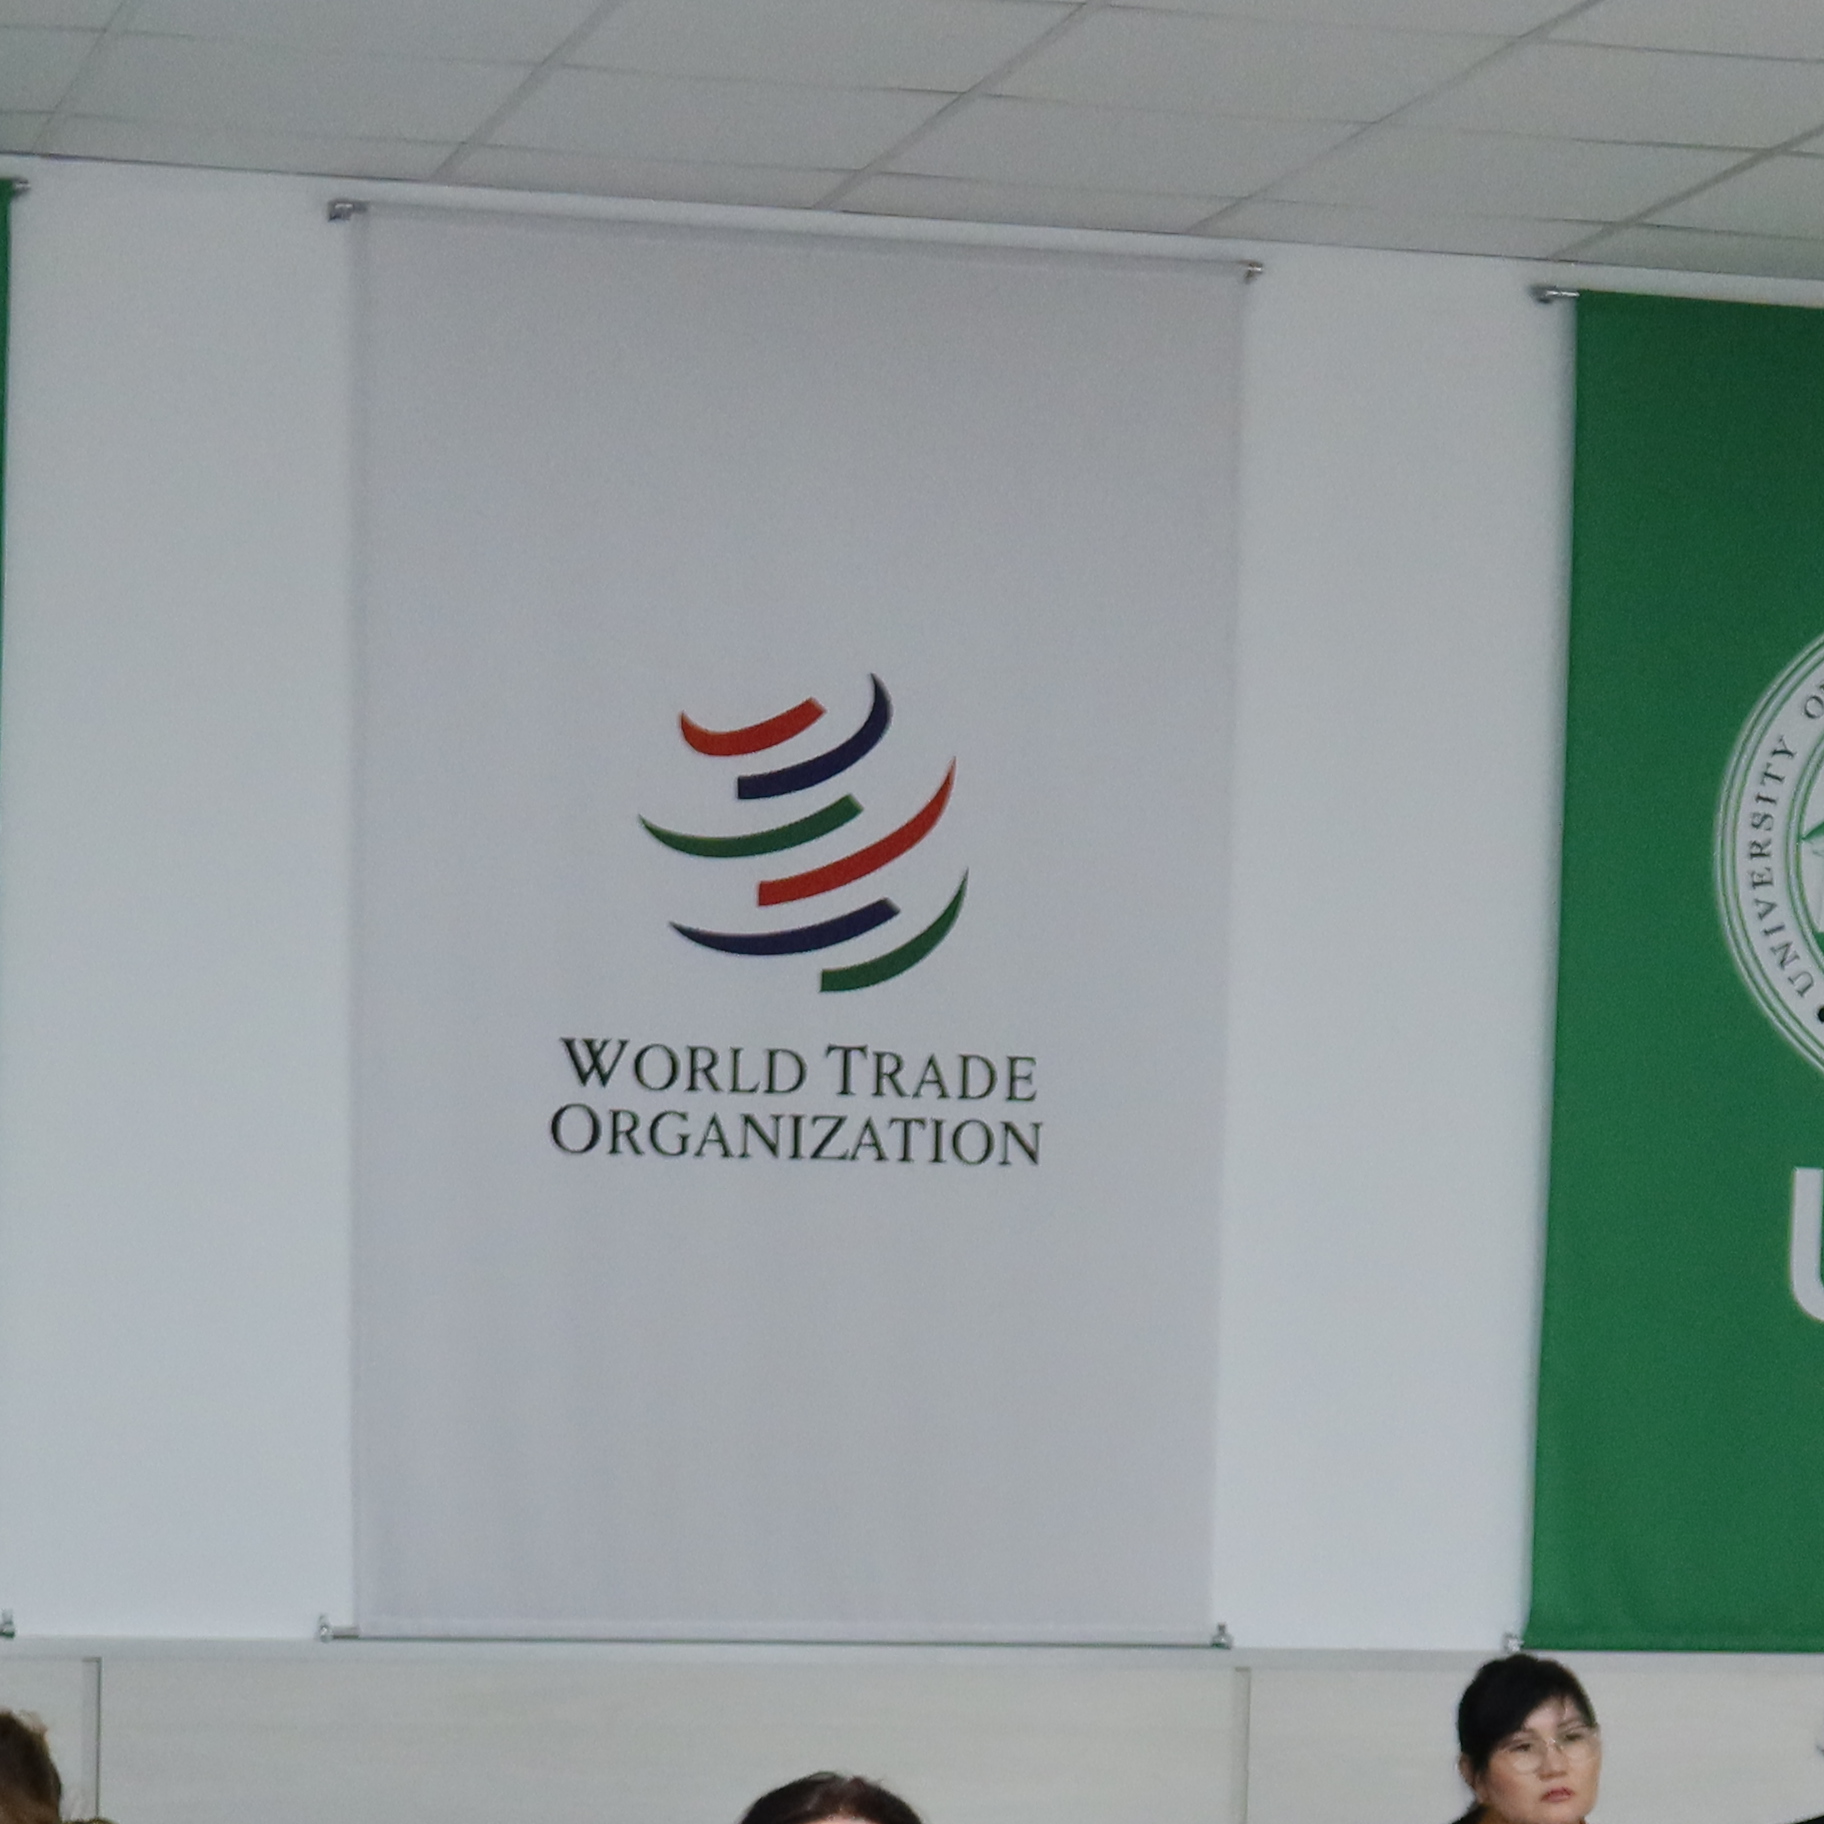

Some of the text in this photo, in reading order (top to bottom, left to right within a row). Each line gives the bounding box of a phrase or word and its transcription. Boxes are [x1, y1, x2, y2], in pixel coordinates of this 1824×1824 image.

[1749, 735, 1815, 999] UNIVERSITY
[560, 1037, 1039, 1102] WORLD TRADE
[550, 1103, 1044, 1166] ORGANIZATION
